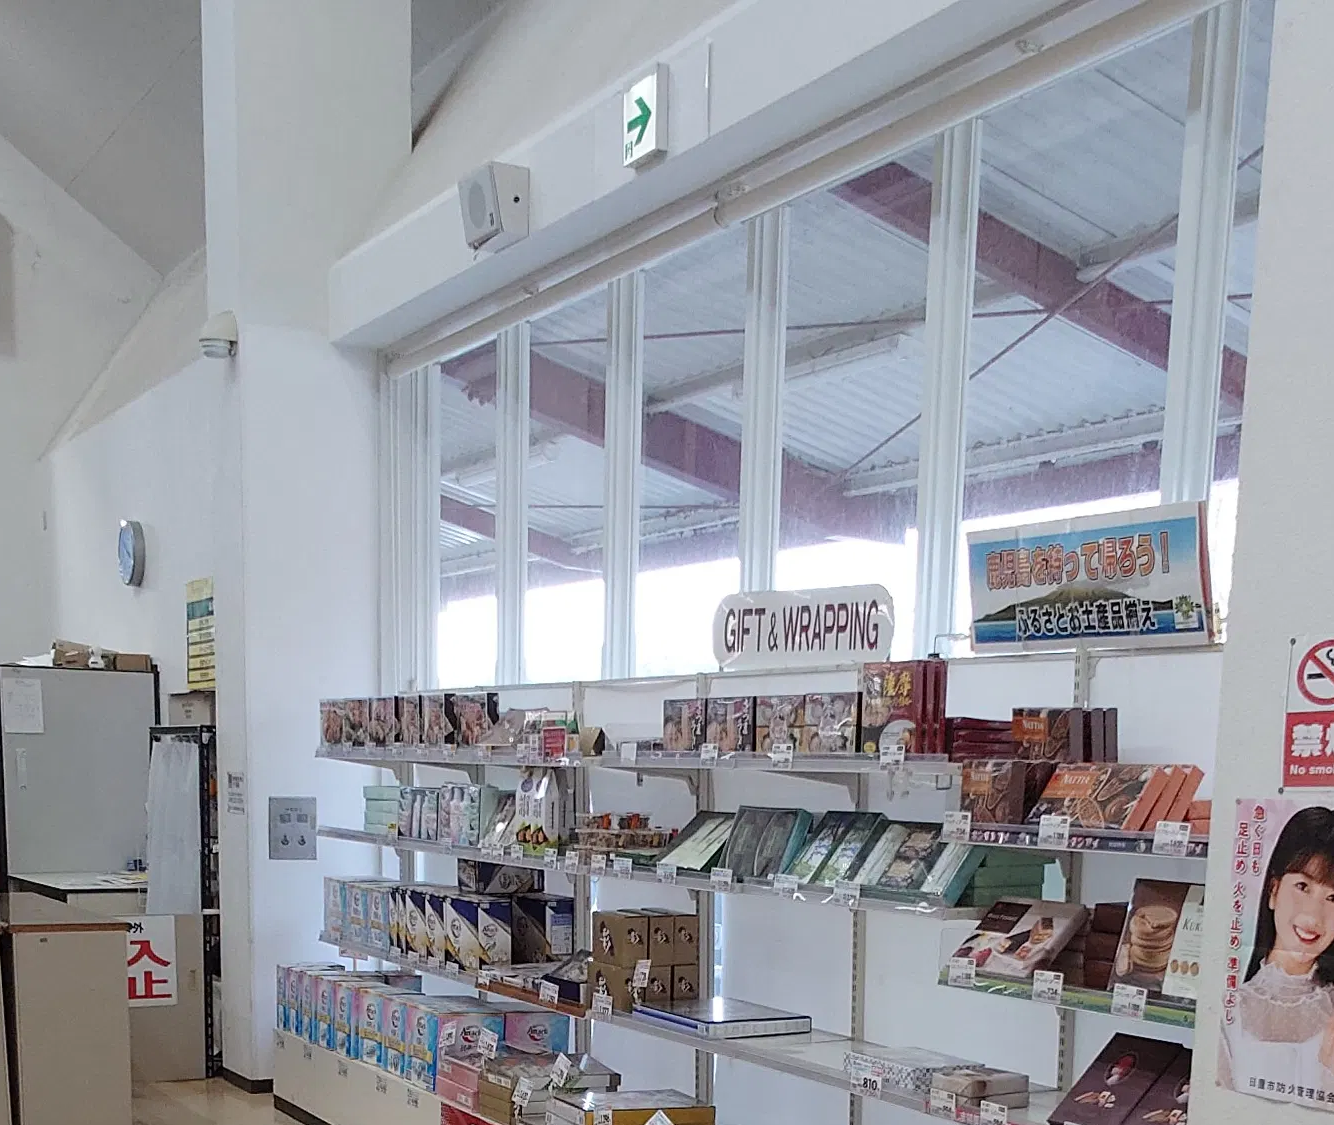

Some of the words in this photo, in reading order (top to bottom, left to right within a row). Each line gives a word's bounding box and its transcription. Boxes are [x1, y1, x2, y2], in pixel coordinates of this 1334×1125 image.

[724, 608, 766, 653] GIFT
[768, 612, 778, 651] &
[783, 600, 880, 652] WRAPPING
[1290, 764, 1306, 775] No
[1235, 822, 1249, 876] 足止め
[1251, 805, 1265, 875] 急ぐ日も
[1229, 882, 1245, 949] 火を止め
[862, 1077, 878, 1090] 810
